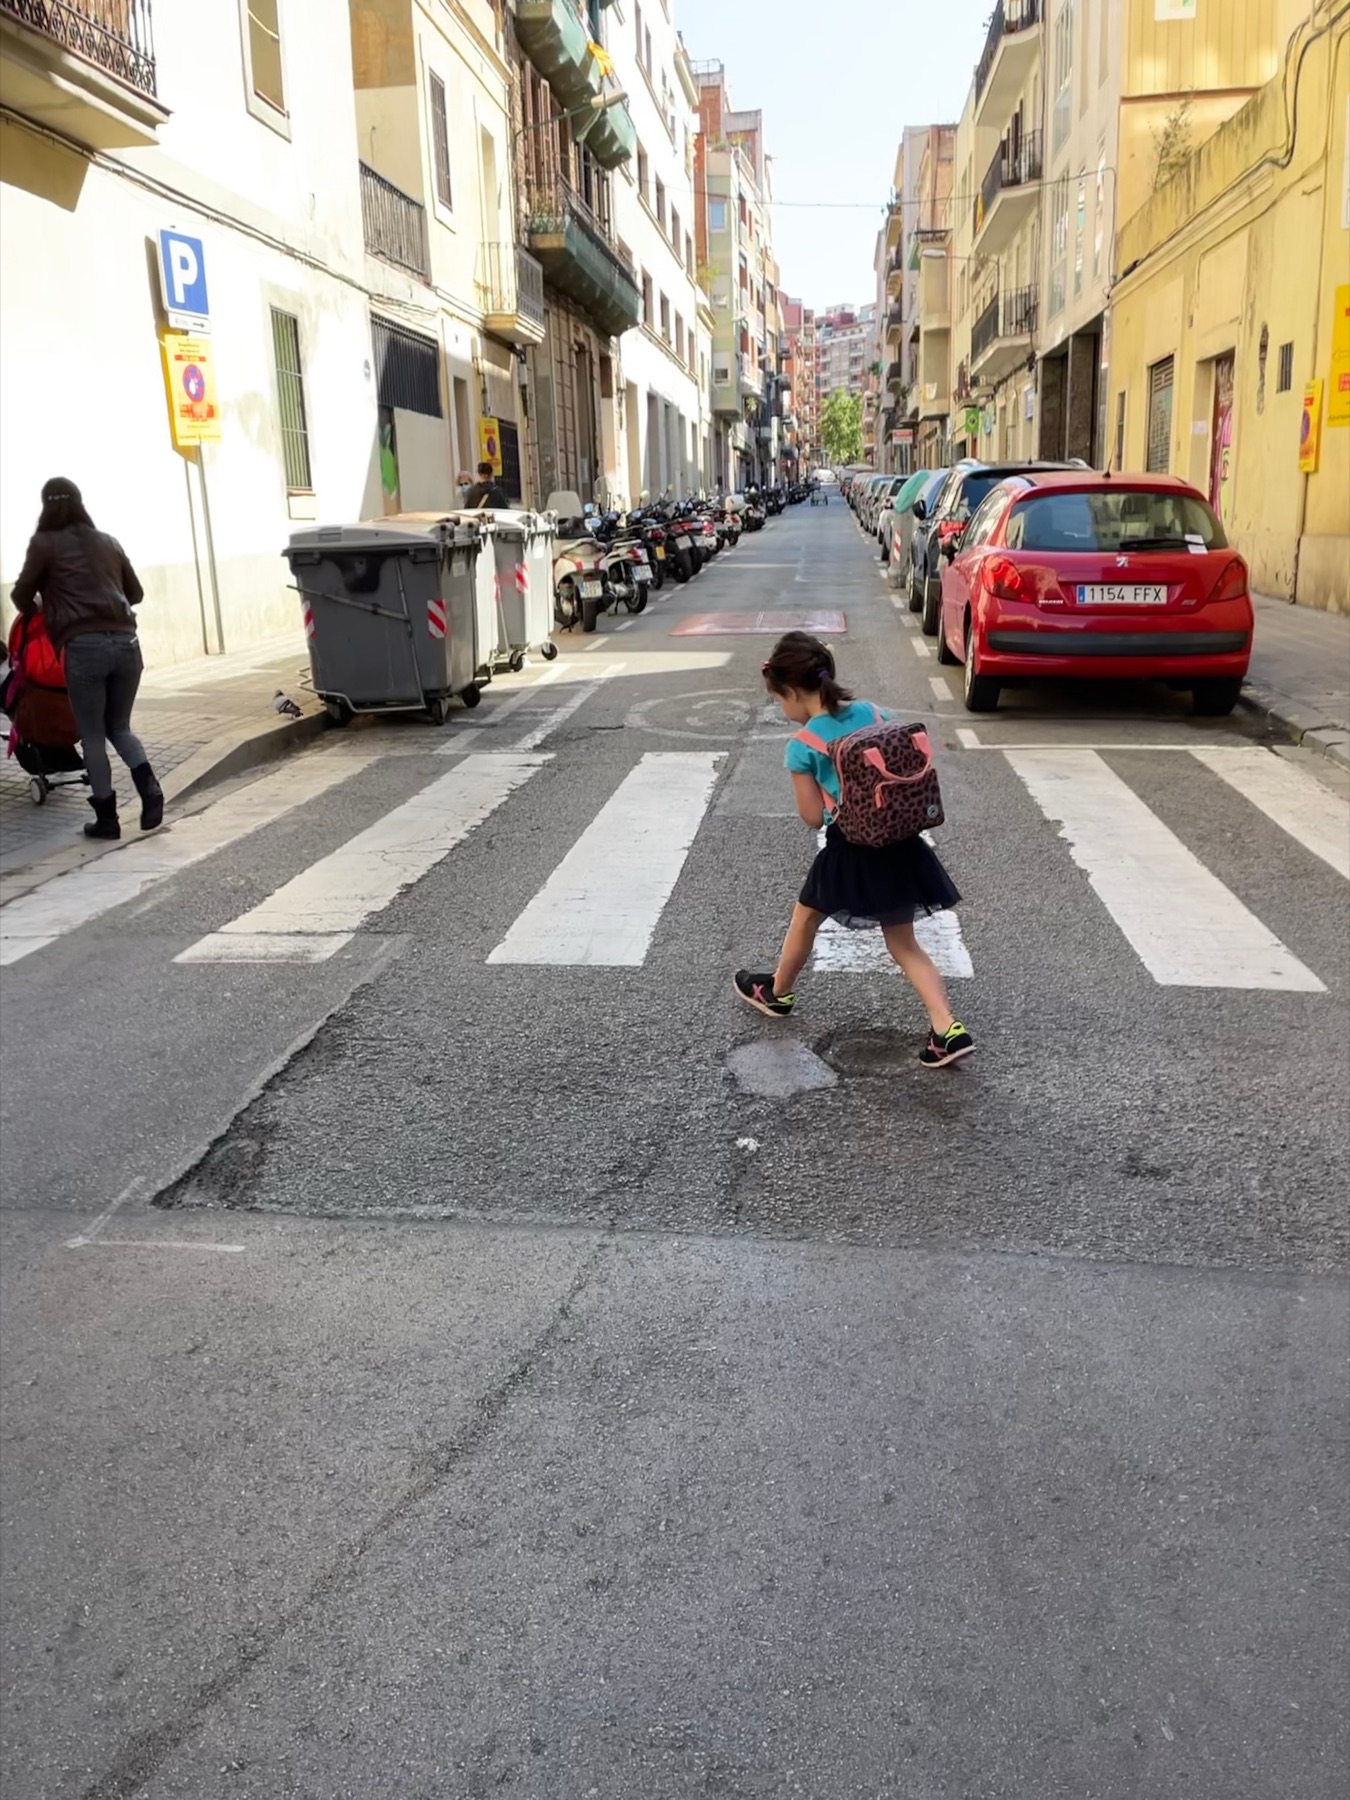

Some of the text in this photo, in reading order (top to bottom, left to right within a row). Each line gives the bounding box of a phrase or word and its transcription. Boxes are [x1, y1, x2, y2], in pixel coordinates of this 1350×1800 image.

[169, 239, 198, 304] P
[1090, 587, 1162, 602] 1154 FFX
